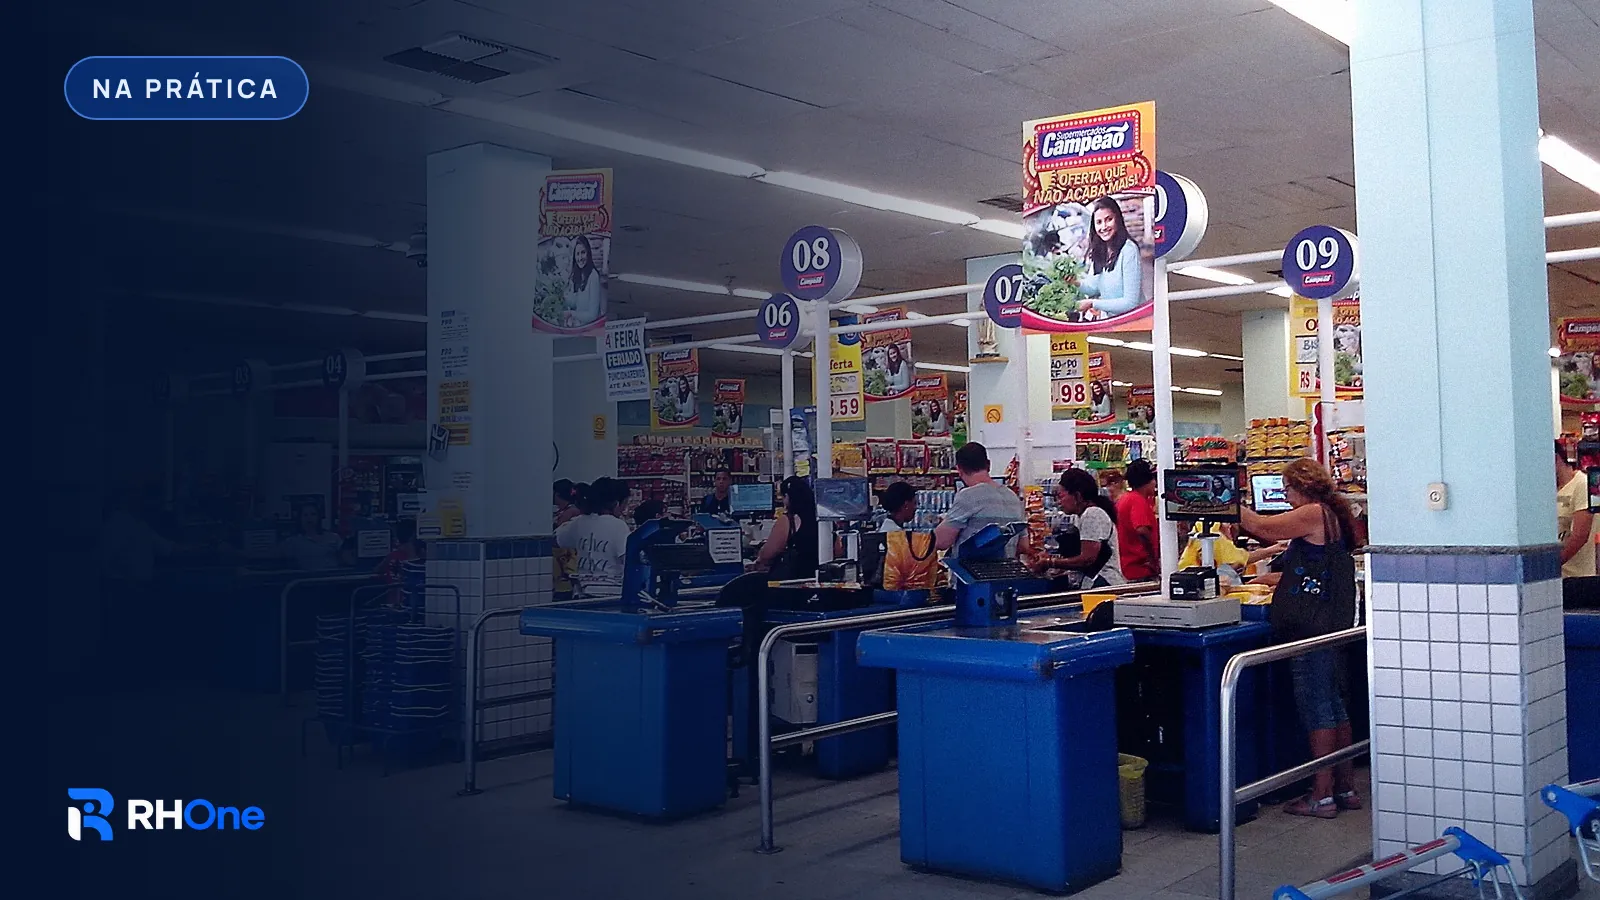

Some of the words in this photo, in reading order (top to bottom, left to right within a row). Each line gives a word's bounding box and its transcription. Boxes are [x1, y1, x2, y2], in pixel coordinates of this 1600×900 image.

[1042, 122, 1130, 158] Campeão
[1056, 127, 1107, 141] Supermercados
[1033, 185, 1064, 205] NÃO
[1064, 185, 1106, 203] ACABA
[1106, 173, 1142, 195] MAIS!
[1058, 170, 1103, 187] OFERTA
[1105, 164, 1127, 183] QUE
[792, 237, 831, 273] 08
[1295, 236, 1340, 271] 09
[995, 275, 1023, 303] 07
[764, 301, 793, 328] 06
[605, 334, 611, 348] 4
[615, 329, 641, 348] FEIRA
[607, 351, 641, 369] FERIADO
